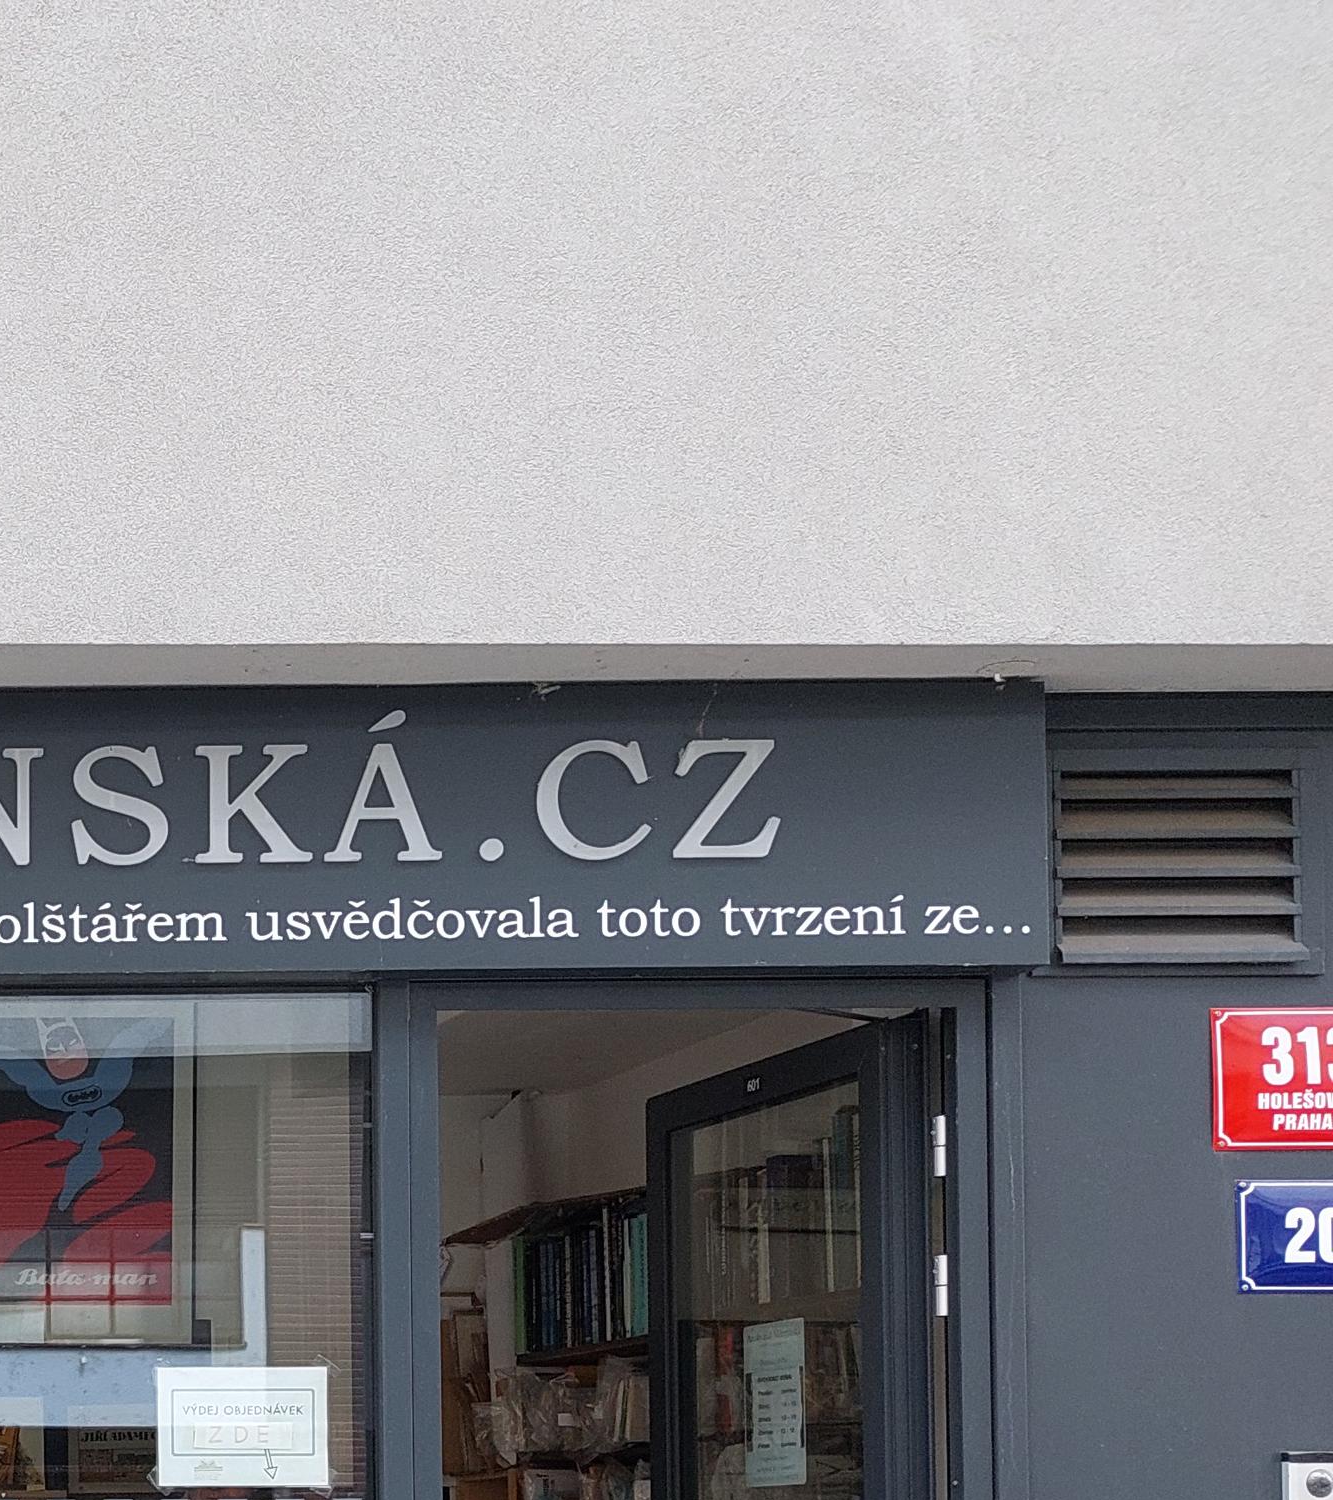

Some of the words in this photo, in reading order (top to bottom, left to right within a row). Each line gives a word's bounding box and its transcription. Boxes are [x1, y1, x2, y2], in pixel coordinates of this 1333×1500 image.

[246, 897, 578, 943] usvědčovala
[597, 903, 702, 938] toto
[720, 897, 904, 937] tvrzení
[924, 903, 1032, 936] ze...
[1261, 1026, 1333, 1085] 31
[182, 1402, 219, 1415] VÝDEJ
[223, 1403, 306, 1415] OBJEDNÁVEK
[209, 1425, 270, 1443] ZDE
